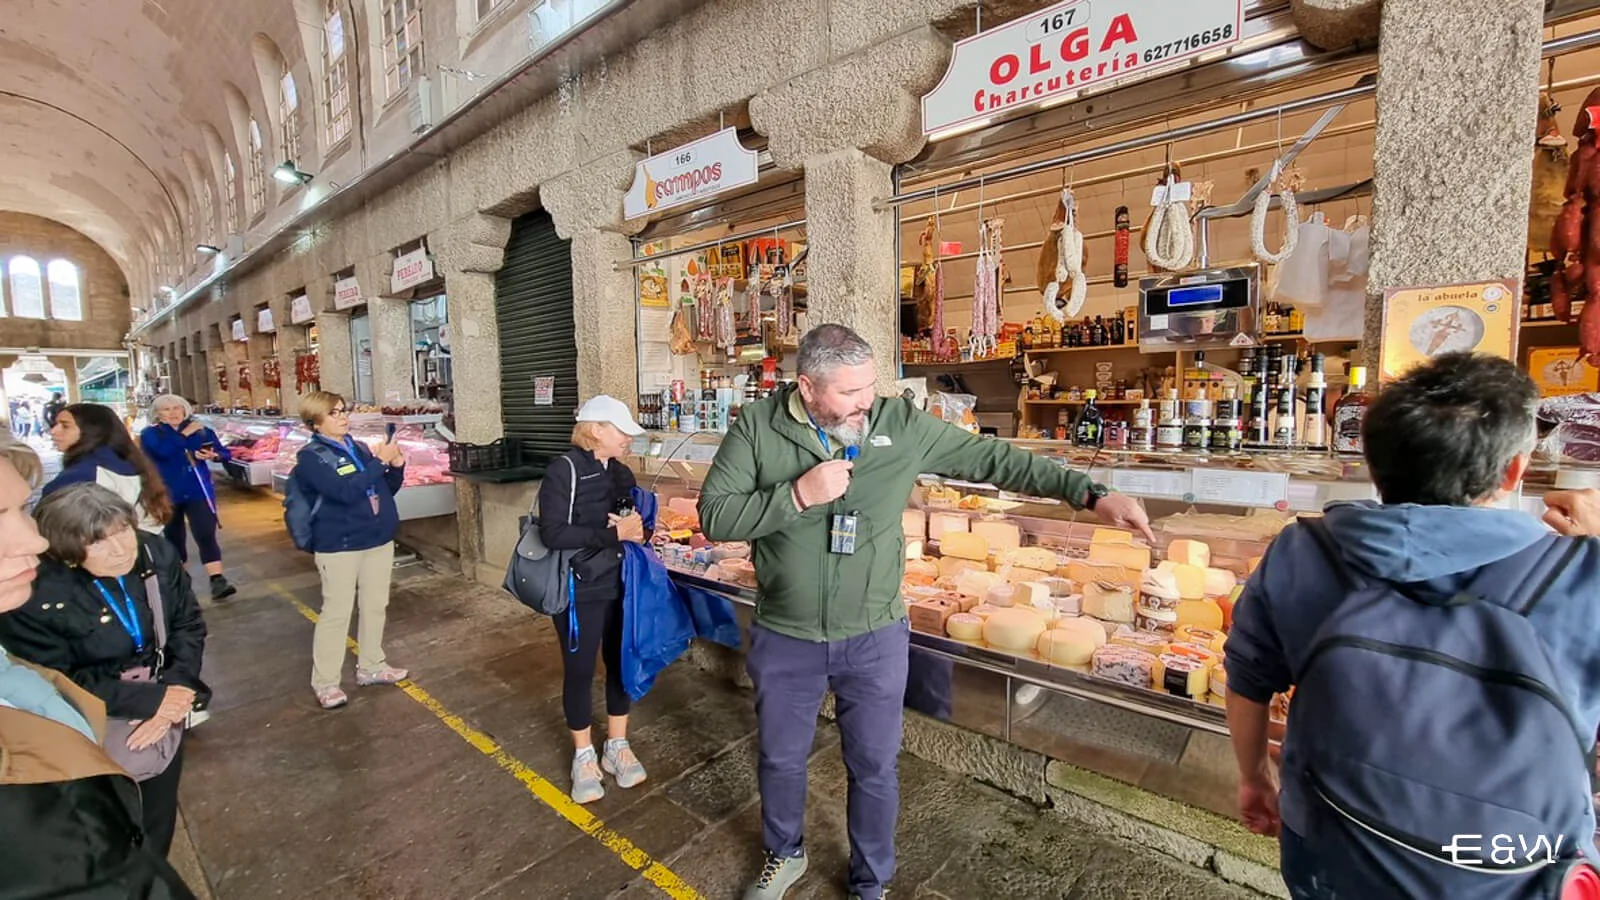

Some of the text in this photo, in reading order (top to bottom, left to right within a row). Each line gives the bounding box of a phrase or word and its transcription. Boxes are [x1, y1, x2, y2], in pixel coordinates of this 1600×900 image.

[1039, 8, 1077, 34] 167
[989, 13, 1138, 85] OLGA
[1143, 24, 1233, 63] 627716658
[974, 51, 1138, 112] Charcutería
[675, 151, 691, 165] 166
[1434, 291, 1478, 300] abuela
